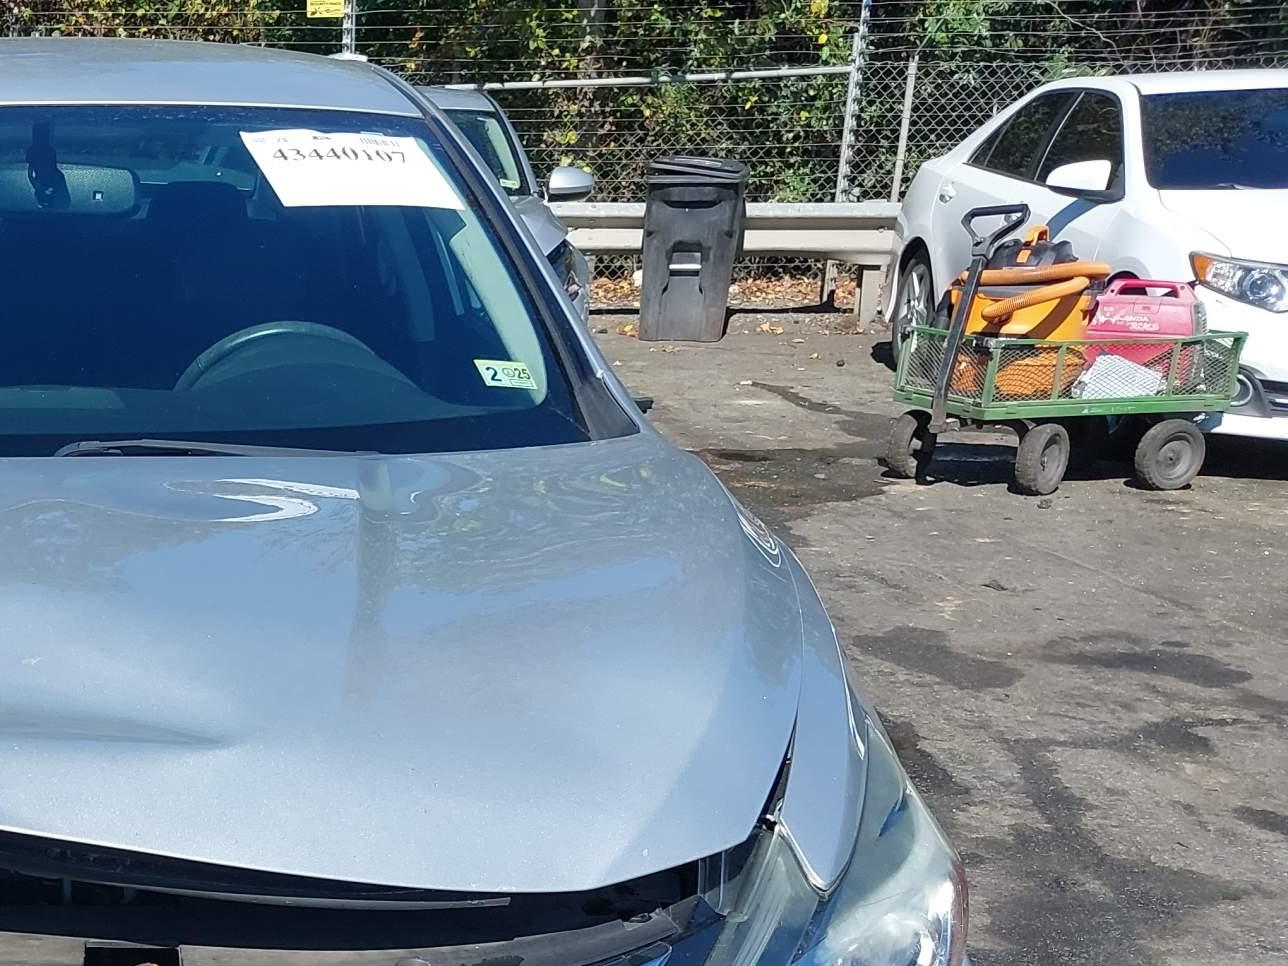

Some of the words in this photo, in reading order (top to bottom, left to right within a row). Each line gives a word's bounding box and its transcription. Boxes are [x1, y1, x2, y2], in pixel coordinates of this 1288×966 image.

[272, 146, 406, 164] 43440107
[485, 366, 502, 382] 2
[513, 367, 531, 380] 25
